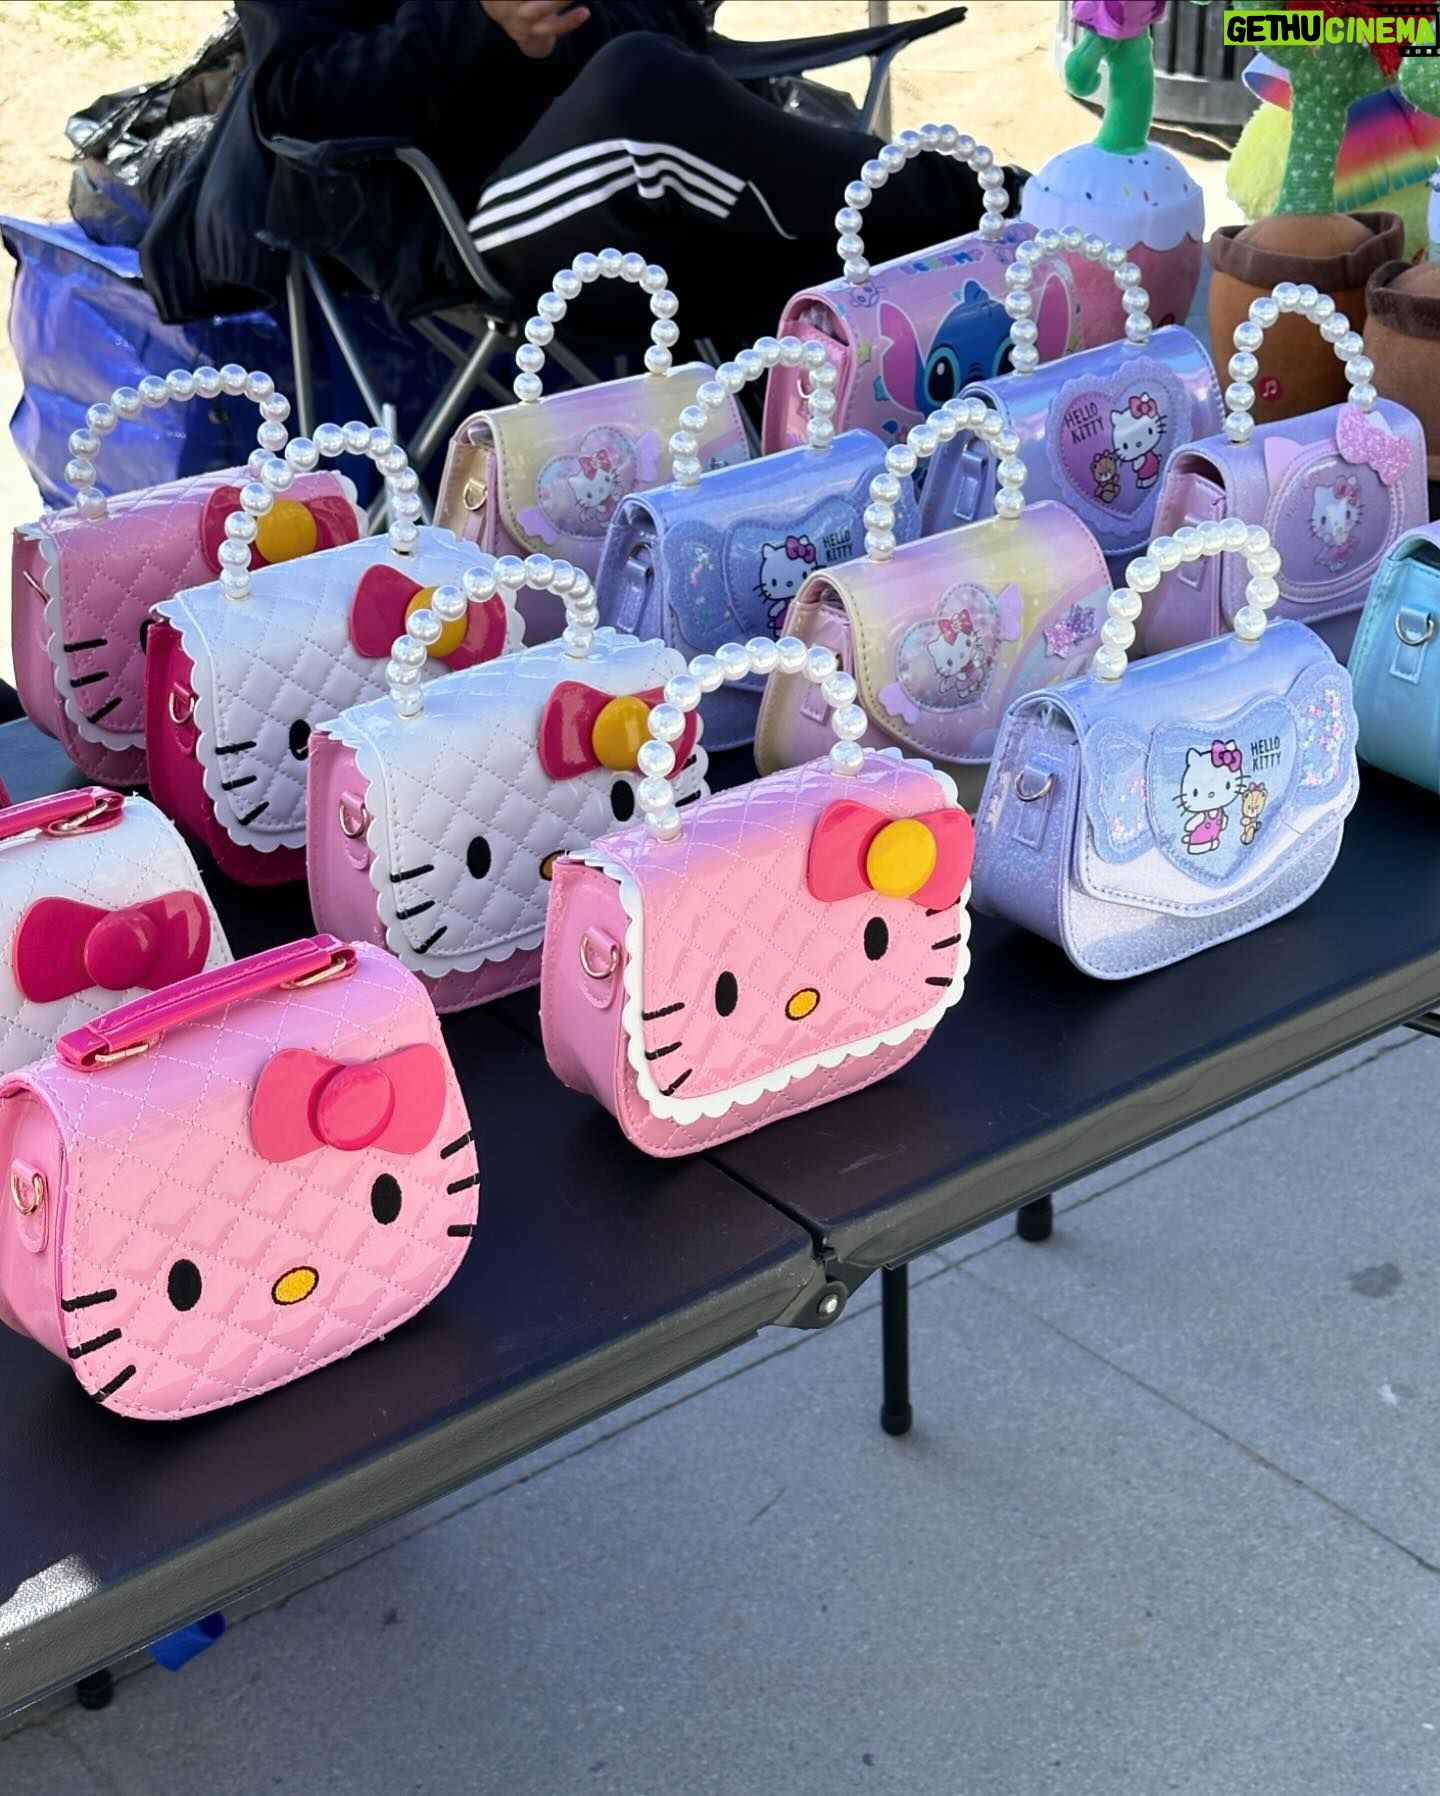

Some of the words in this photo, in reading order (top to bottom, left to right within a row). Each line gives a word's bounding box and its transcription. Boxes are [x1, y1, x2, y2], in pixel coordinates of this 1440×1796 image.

[1064, 402, 1098, 428] HELLO
[1071, 416, 1104, 444] KITTY
[823, 530, 851, 548] HELLO
[826, 544, 853, 561] KITTY
[1251, 736, 1280, 756] HELLO
[1253, 751, 1281, 772] KITTY
